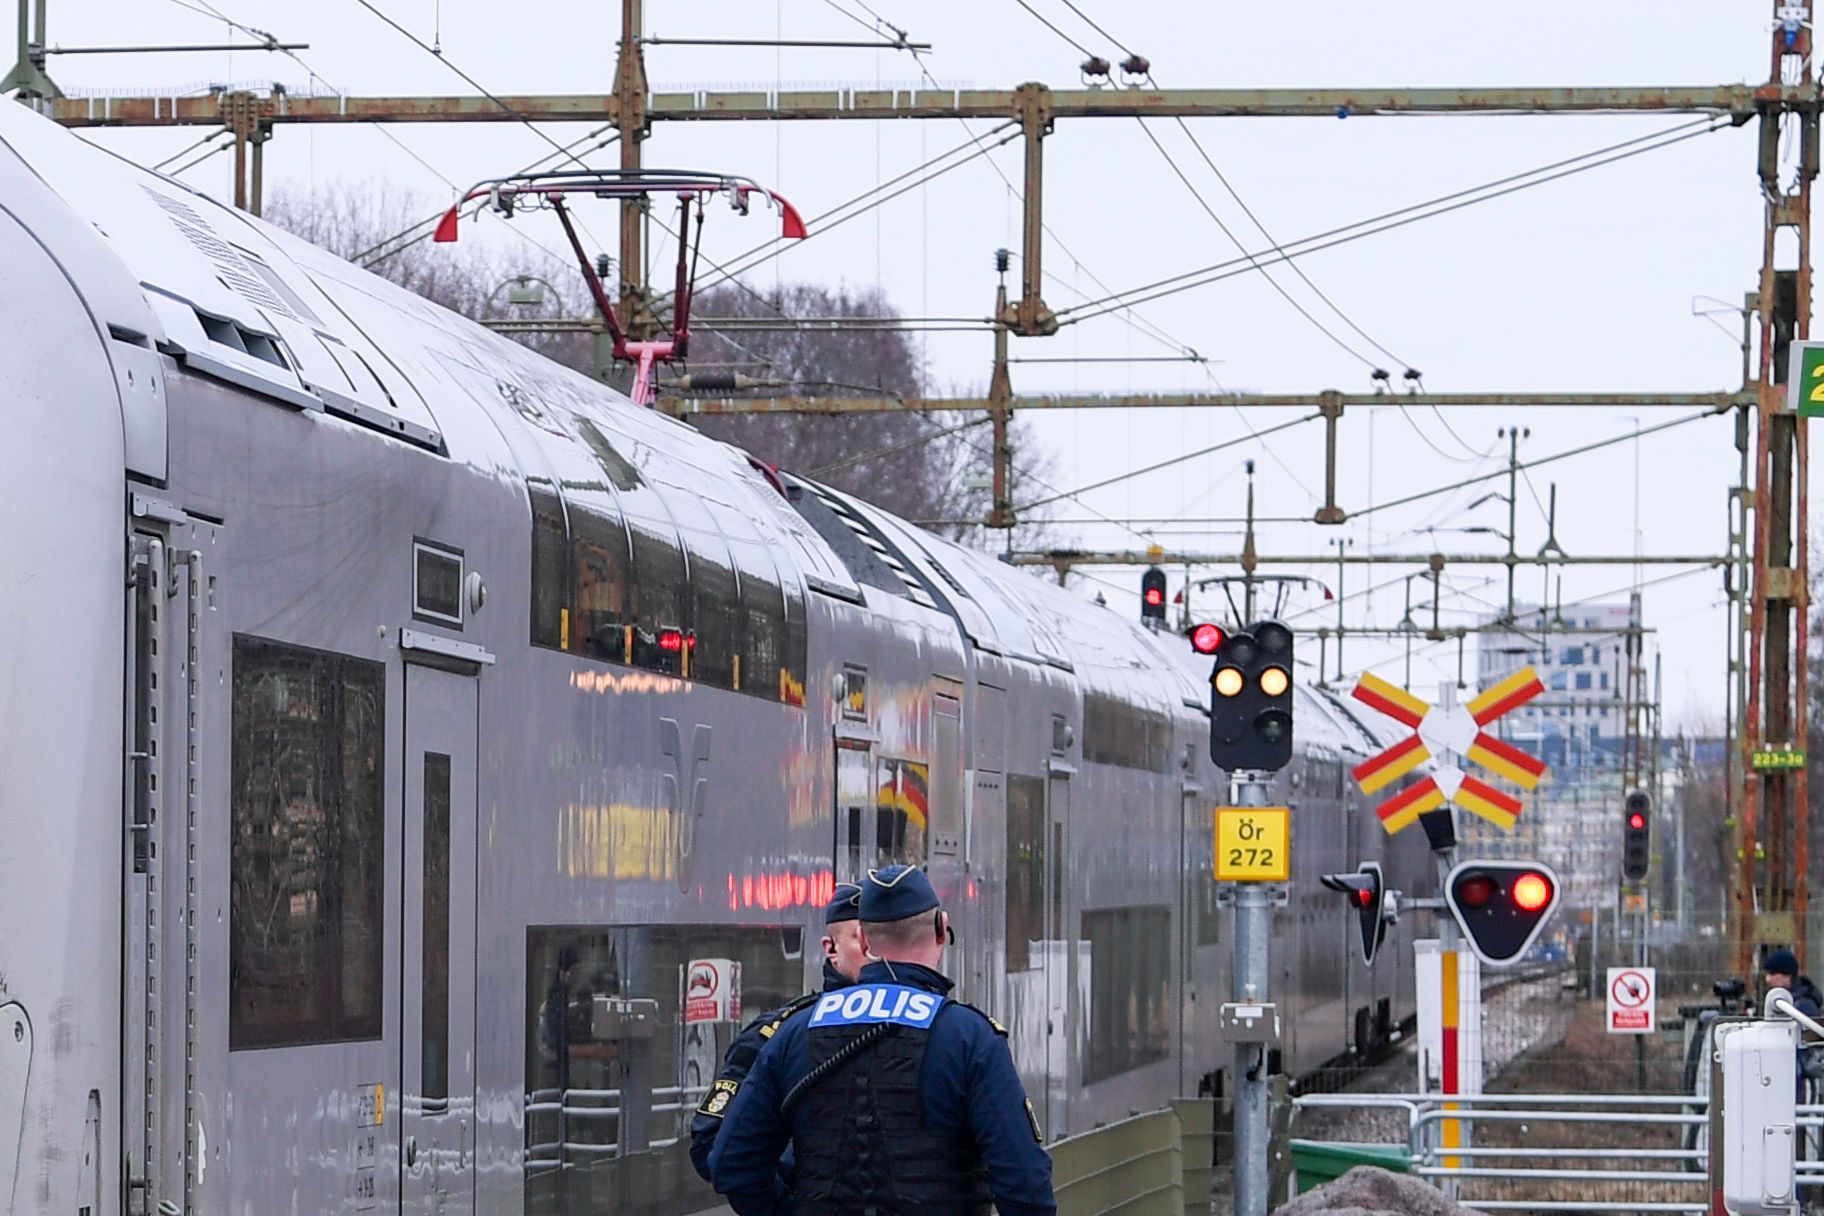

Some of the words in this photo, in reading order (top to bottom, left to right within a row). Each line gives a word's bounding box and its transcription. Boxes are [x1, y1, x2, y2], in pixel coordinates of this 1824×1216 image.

[1238, 818, 1265, 841] Ör
[1229, 848, 1274, 867] 272
[813, 989, 936, 1022] POLIS
